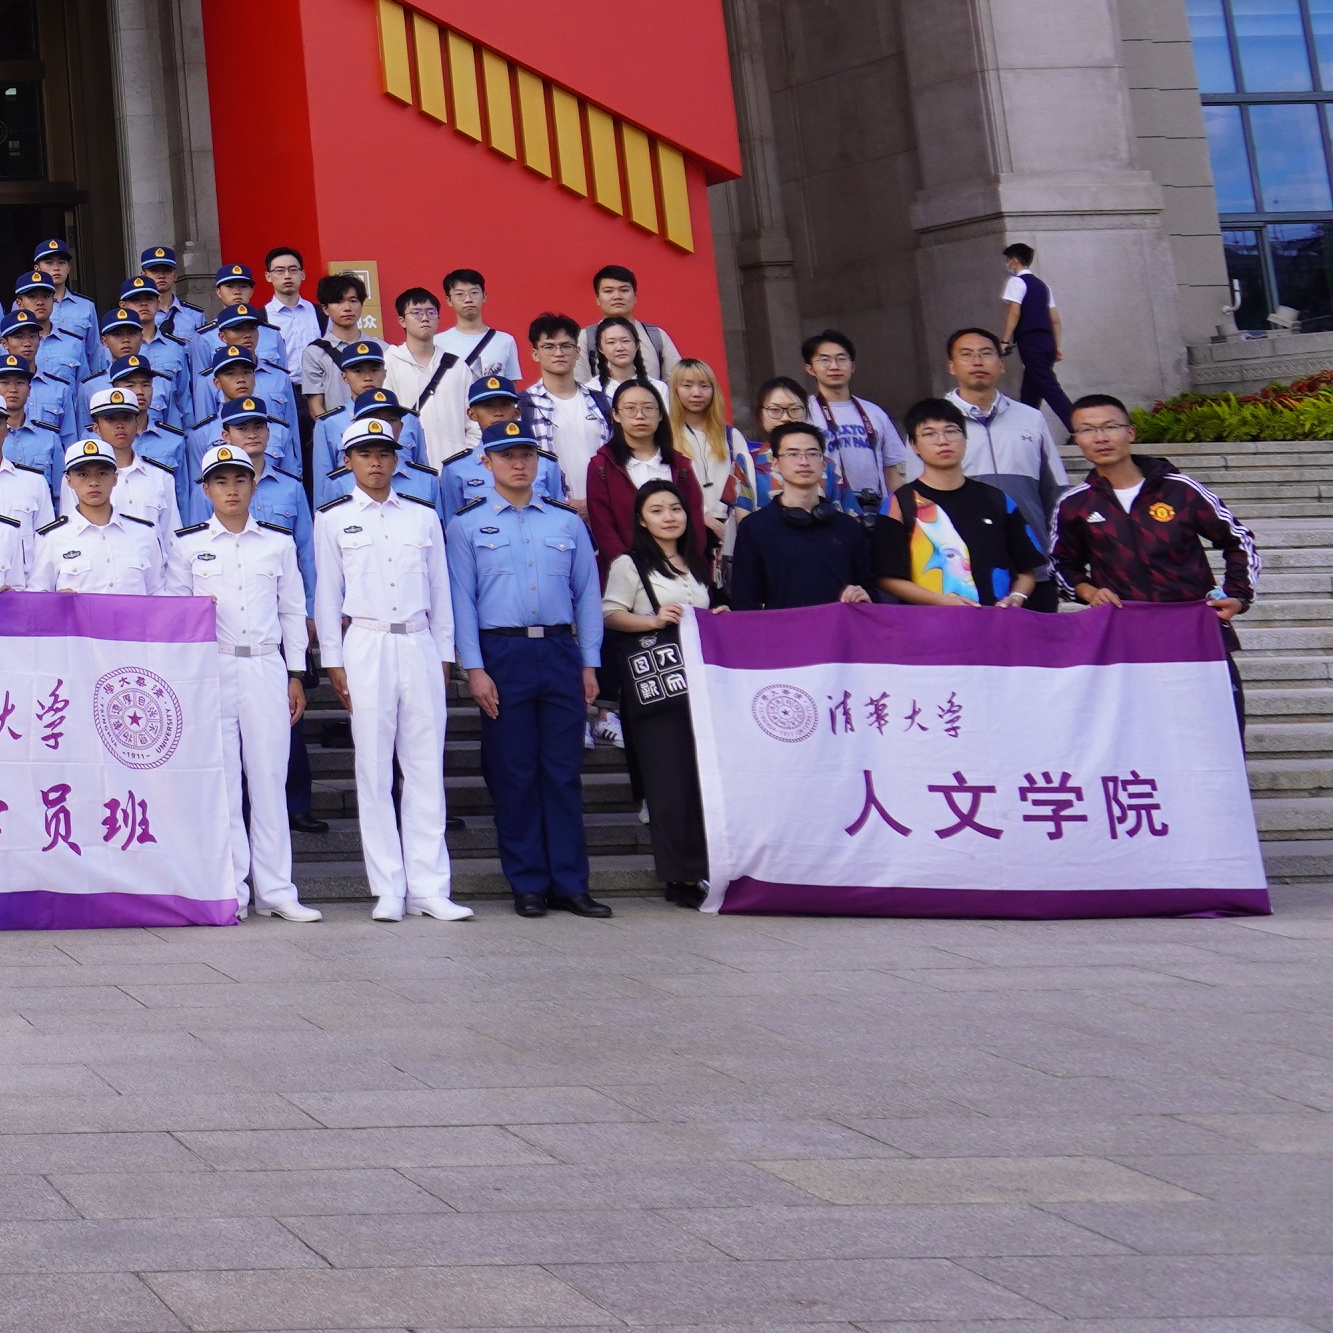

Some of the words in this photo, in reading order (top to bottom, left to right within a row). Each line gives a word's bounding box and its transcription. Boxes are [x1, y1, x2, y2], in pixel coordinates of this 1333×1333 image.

[155, 708, 173, 754] UNIVERSITY
[844, 769, 1170, 841] 人文学院
